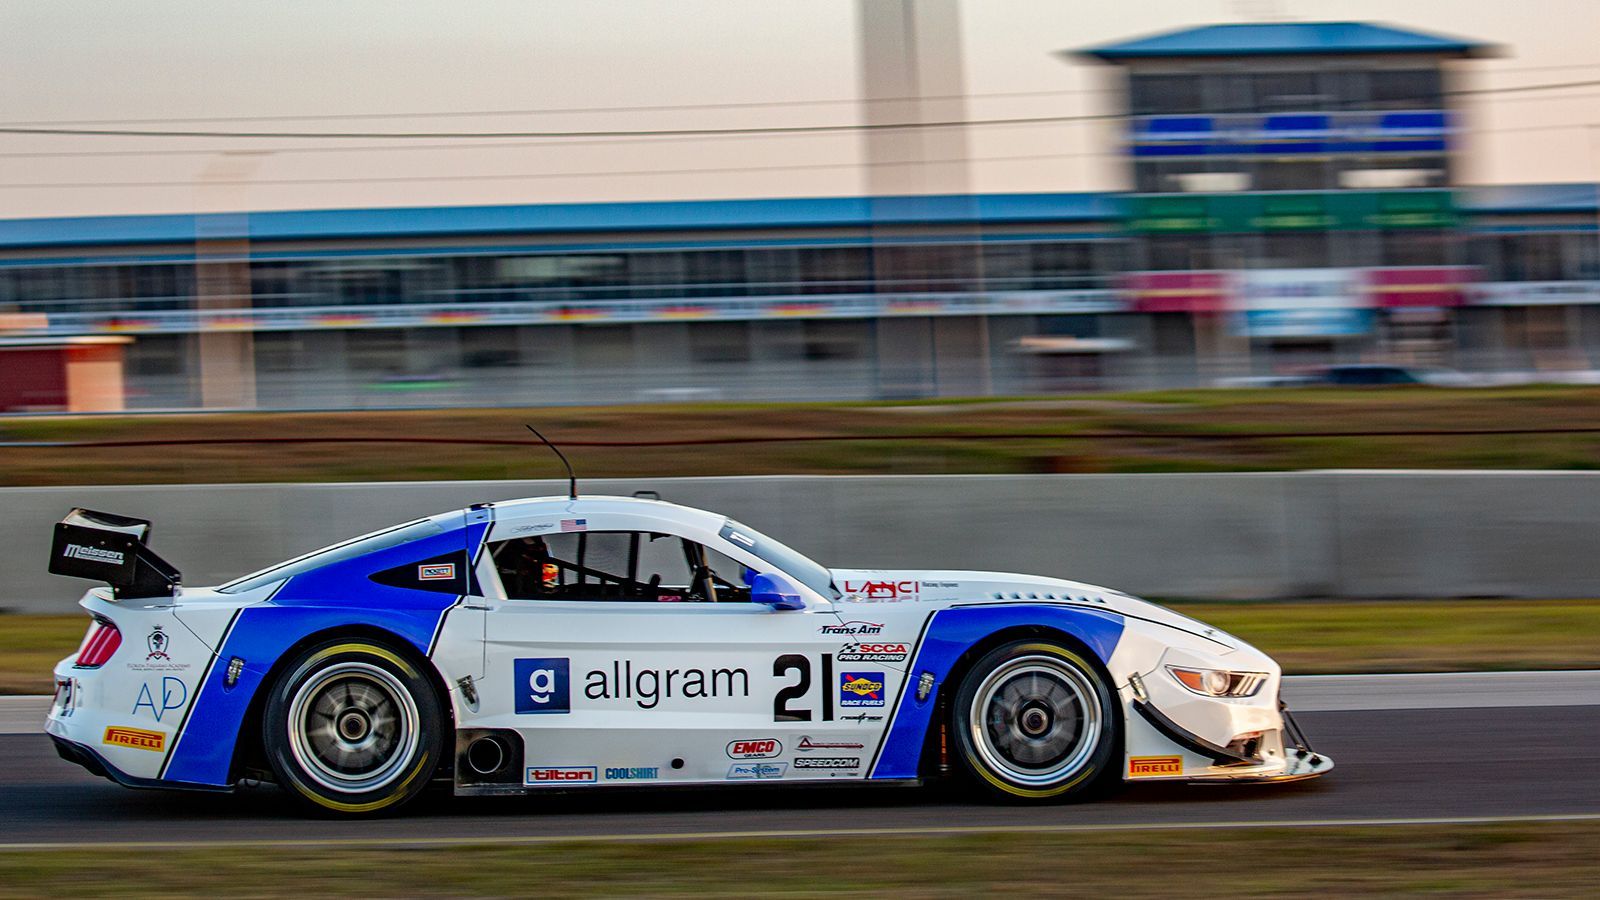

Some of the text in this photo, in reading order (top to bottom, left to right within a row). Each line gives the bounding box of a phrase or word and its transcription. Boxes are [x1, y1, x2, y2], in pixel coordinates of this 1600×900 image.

[64, 544, 124, 559] Meissen
[821, 625, 881, 634] Trans Am
[859, 644, 906, 653] SCCA
[584, 660, 749, 709] allgram
[773, 653, 834, 722] 21
[106, 729, 162, 748] PIRELLI
[732, 741, 775, 754] EMCO
[795, 758, 859, 767] SPEEDCOM
[1130, 758, 1180, 773] PIRELLI
[531, 769, 592, 780] tilton
[605, 767, 659, 779] COOLSHIRT
